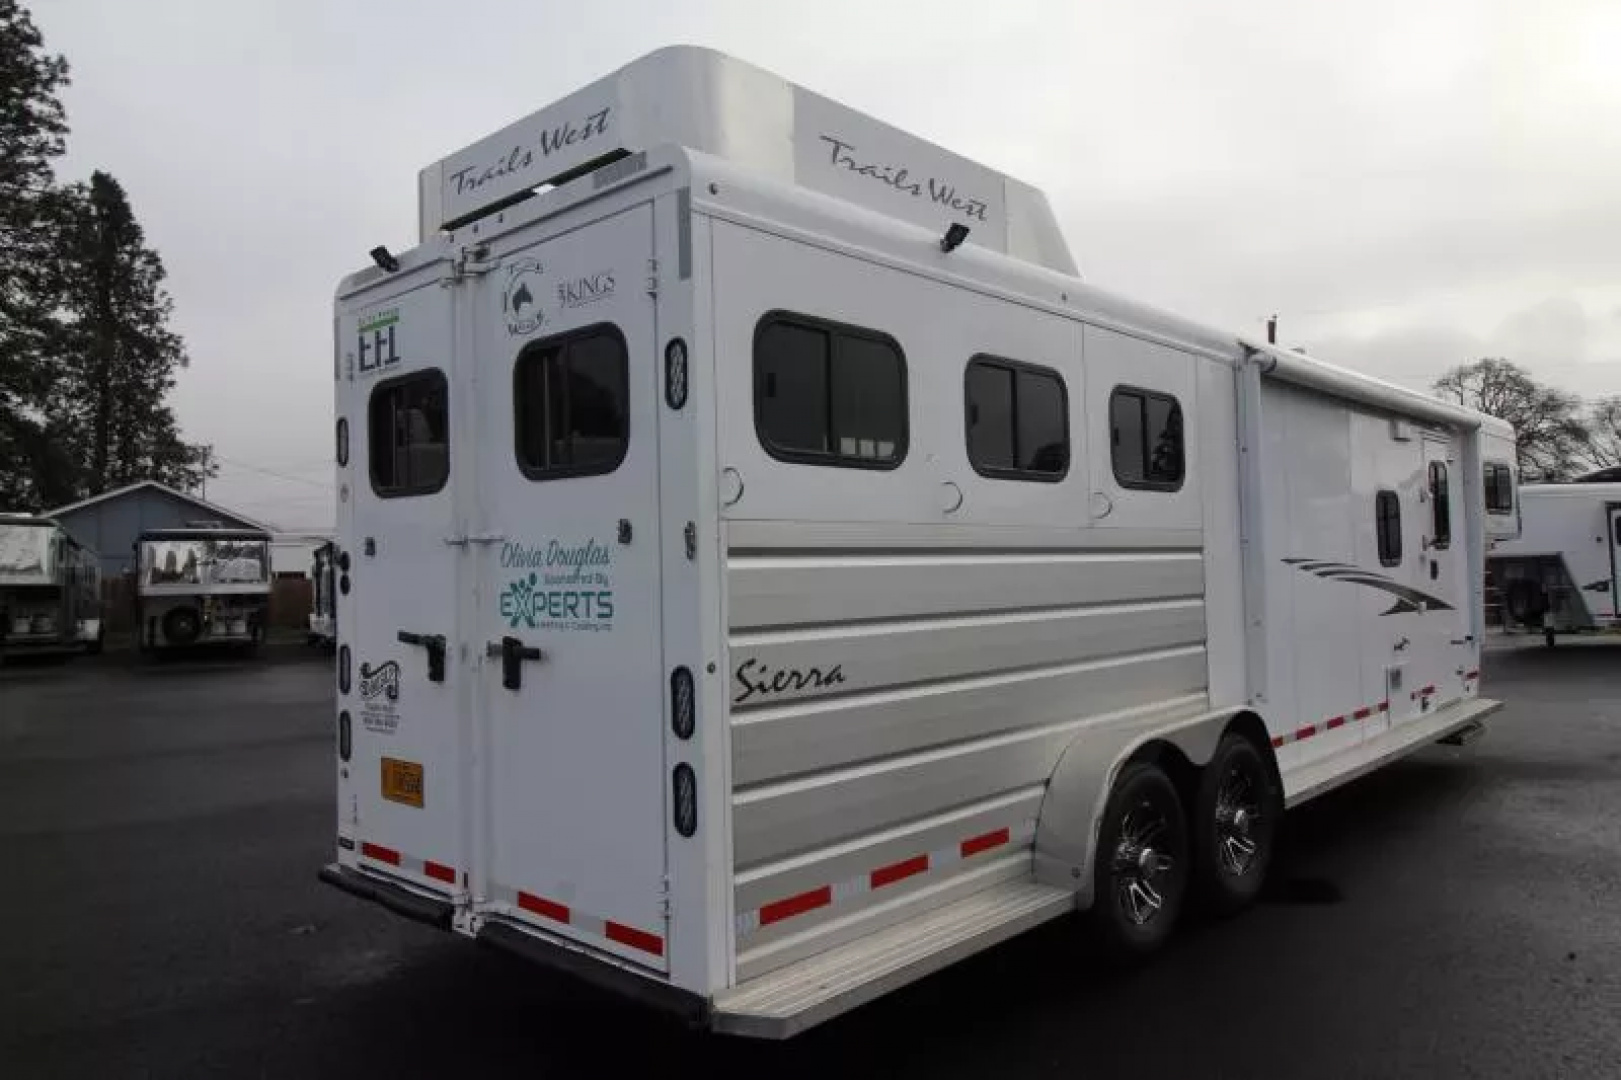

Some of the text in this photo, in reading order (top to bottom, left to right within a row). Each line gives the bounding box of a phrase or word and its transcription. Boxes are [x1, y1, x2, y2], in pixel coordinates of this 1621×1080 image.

[451, 107, 610, 195] Trails West
[819, 134, 988, 221] Trails West
[500, 537, 610, 578] Olivia Douglas
[500, 572, 613, 628] EXPERTS
[734, 658, 846, 702] Sierra
